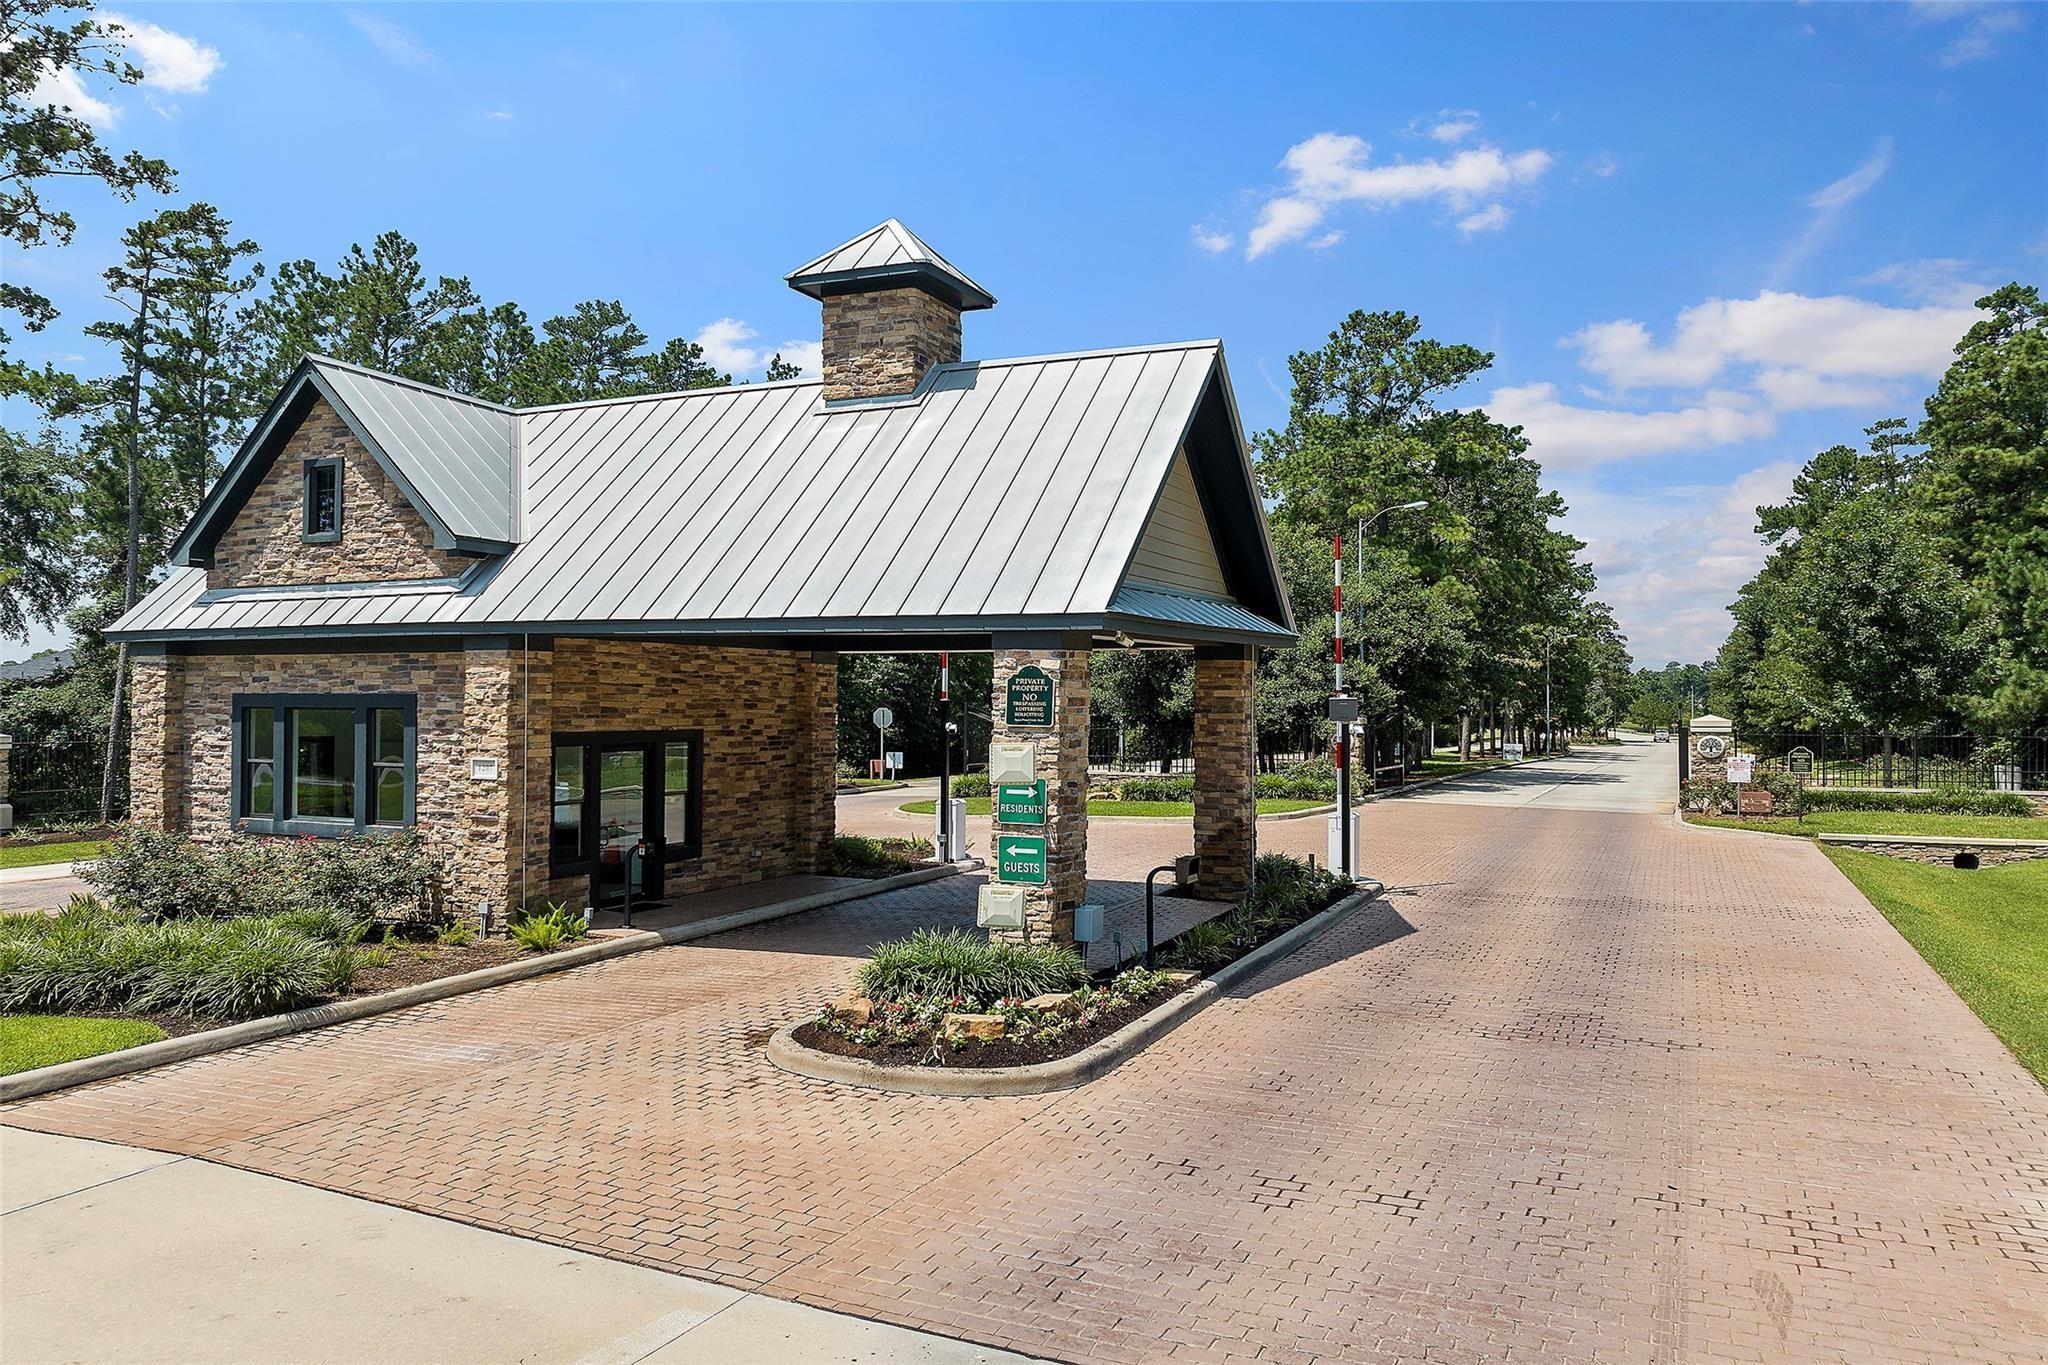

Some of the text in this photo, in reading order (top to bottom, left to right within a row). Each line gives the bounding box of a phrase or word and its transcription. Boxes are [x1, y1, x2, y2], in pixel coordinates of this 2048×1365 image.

[1022, 693, 1037, 701] NO
[1000, 803, 1043, 813] RESIDENTS
[1003, 861, 1040, 873] GUESTS
